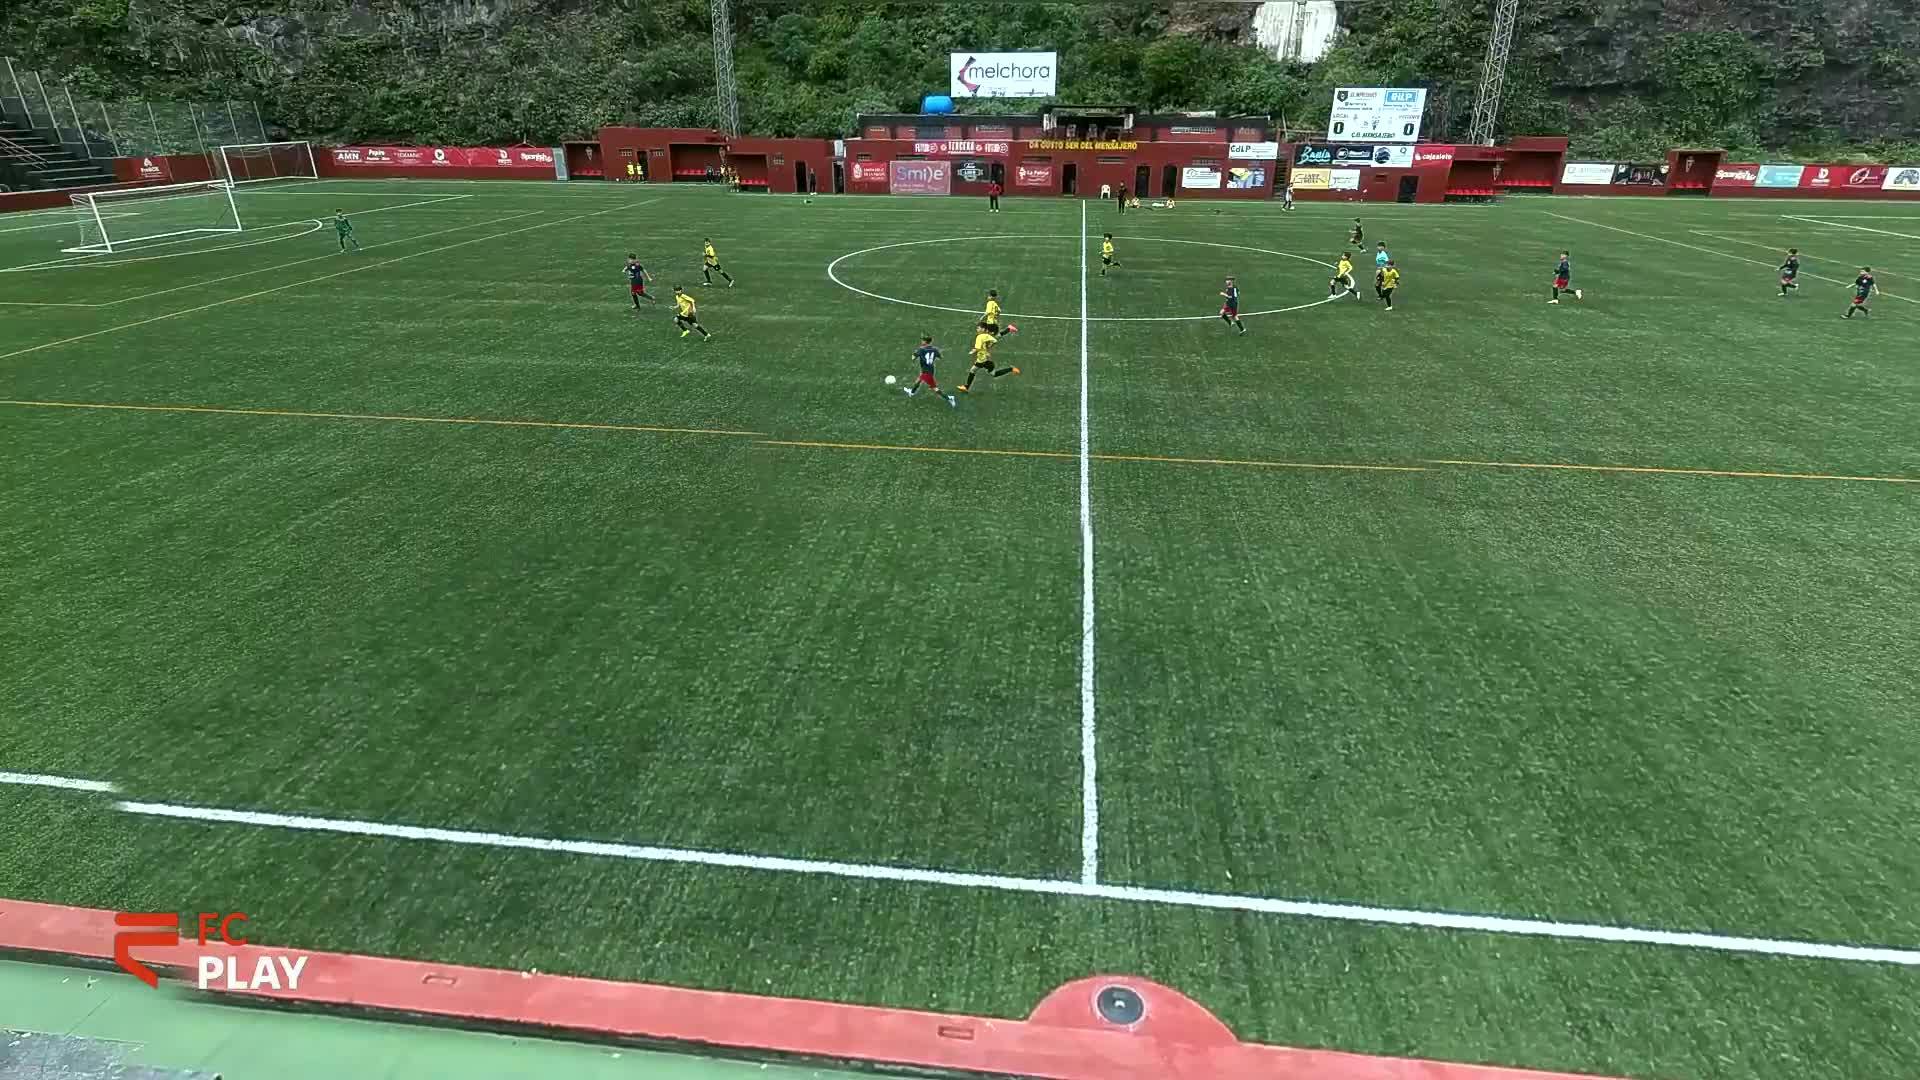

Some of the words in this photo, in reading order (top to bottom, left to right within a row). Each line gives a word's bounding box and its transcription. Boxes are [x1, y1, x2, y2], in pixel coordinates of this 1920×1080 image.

[969, 62, 1050, 79] melchora
[1333, 121, 1345, 134] 0
[1403, 122, 1415, 135] 0
[1064, 141, 1079, 150] SER
[1080, 141, 1094, 150] DEL
[1094, 141, 1138, 150] MENSAJERO
